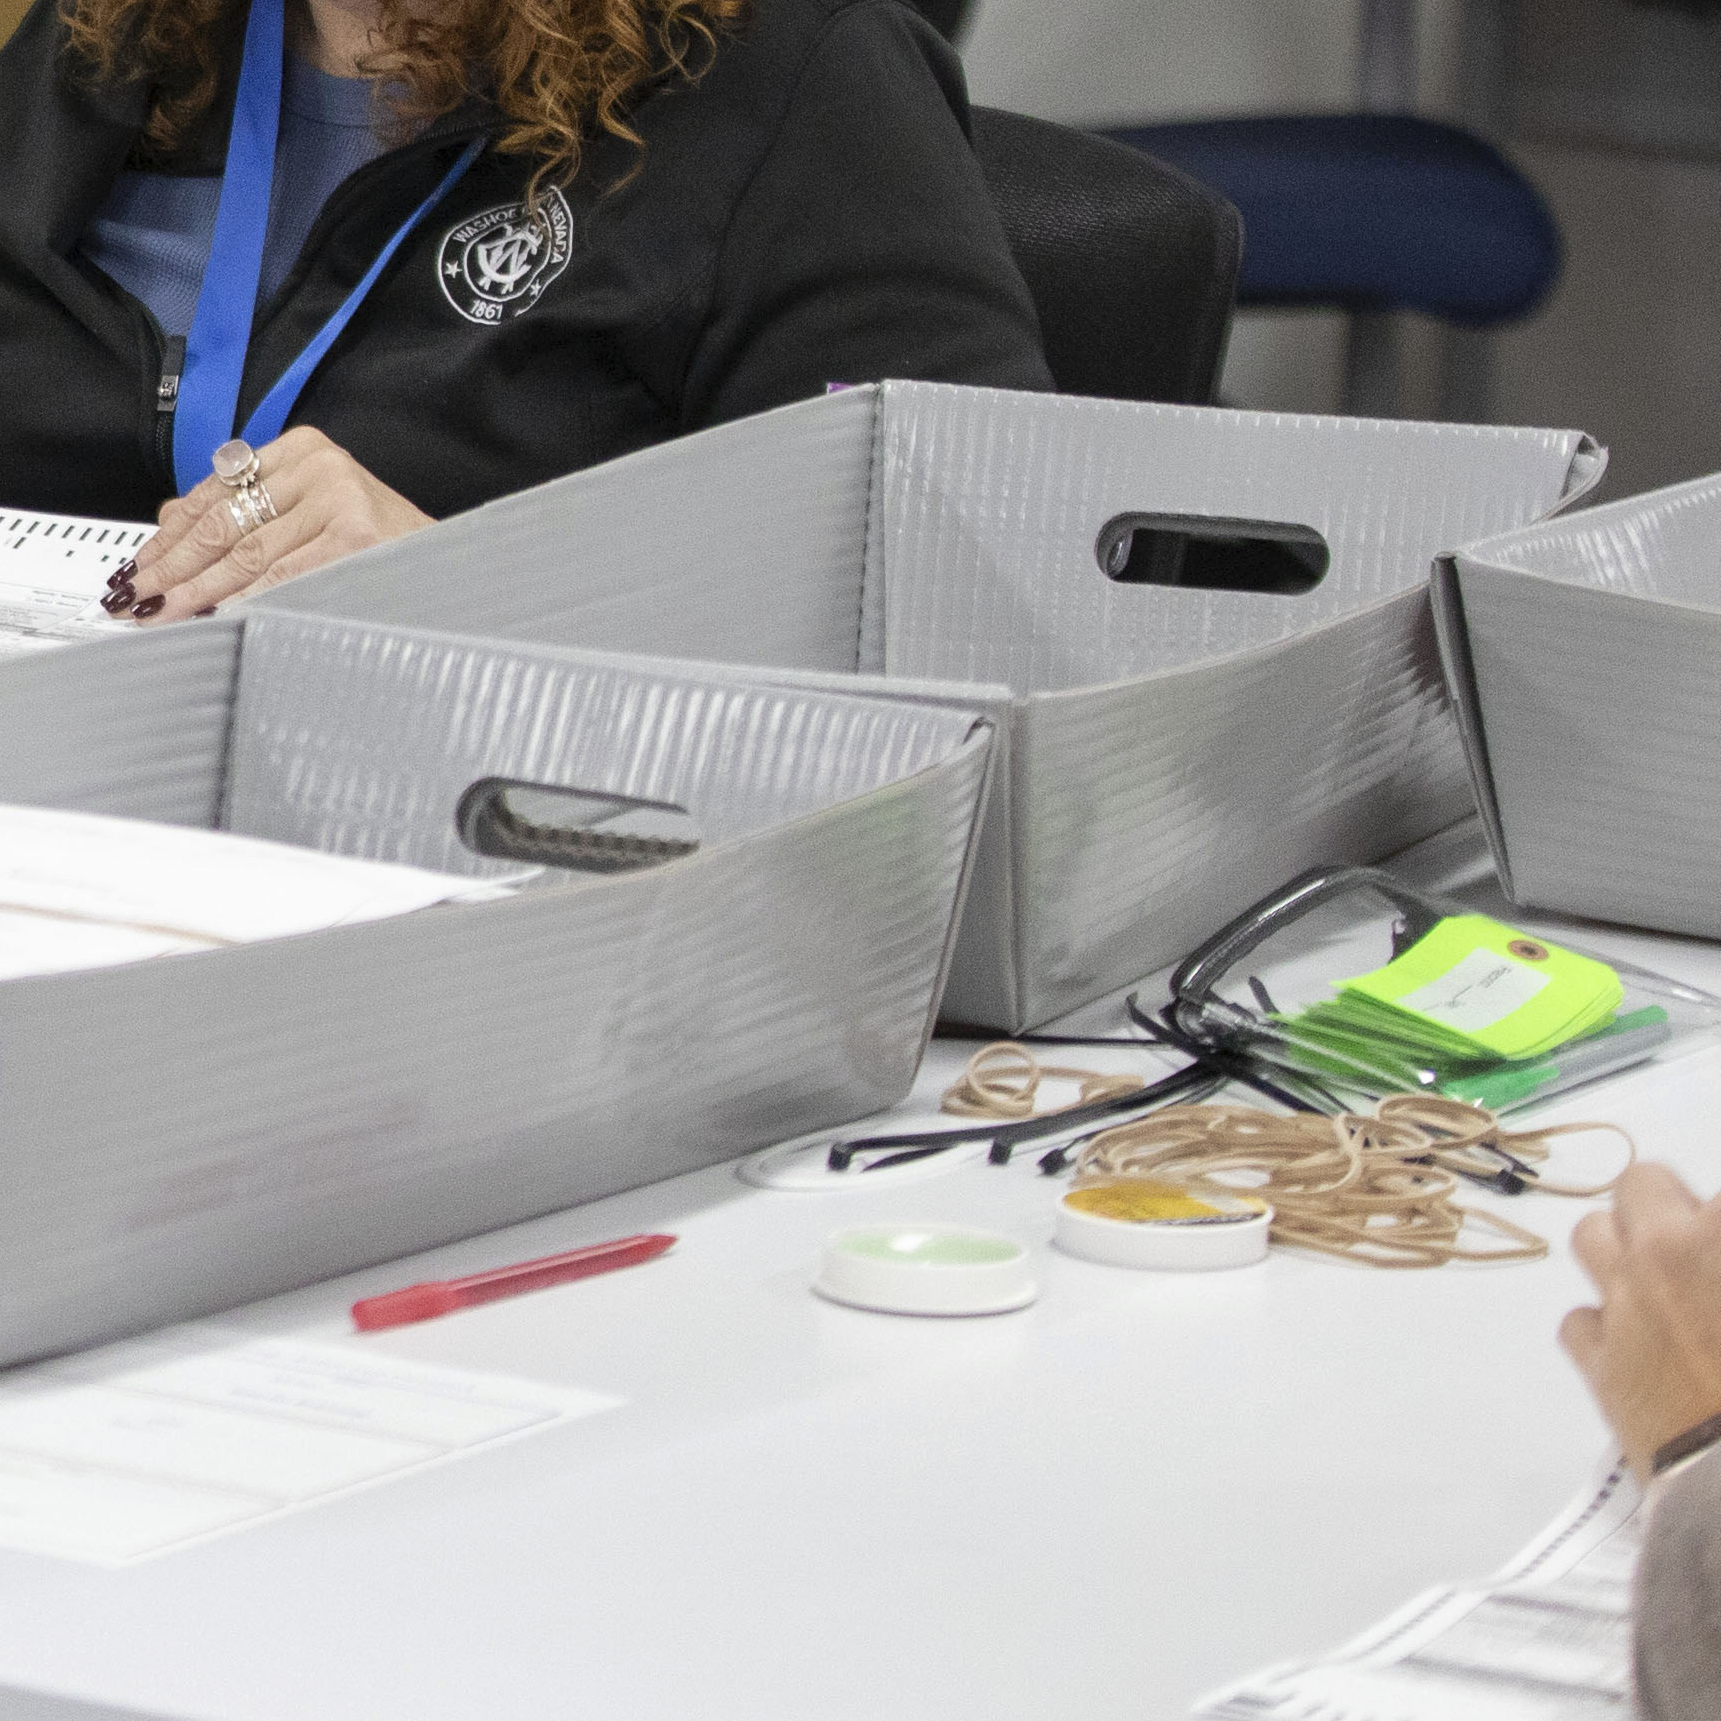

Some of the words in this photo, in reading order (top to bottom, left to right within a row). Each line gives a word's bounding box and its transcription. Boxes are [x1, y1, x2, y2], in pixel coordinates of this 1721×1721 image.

[452, 209, 518, 244] WASHOE
[548, 203, 566, 265] NEVADA
[469, 298, 504, 321] 1861
